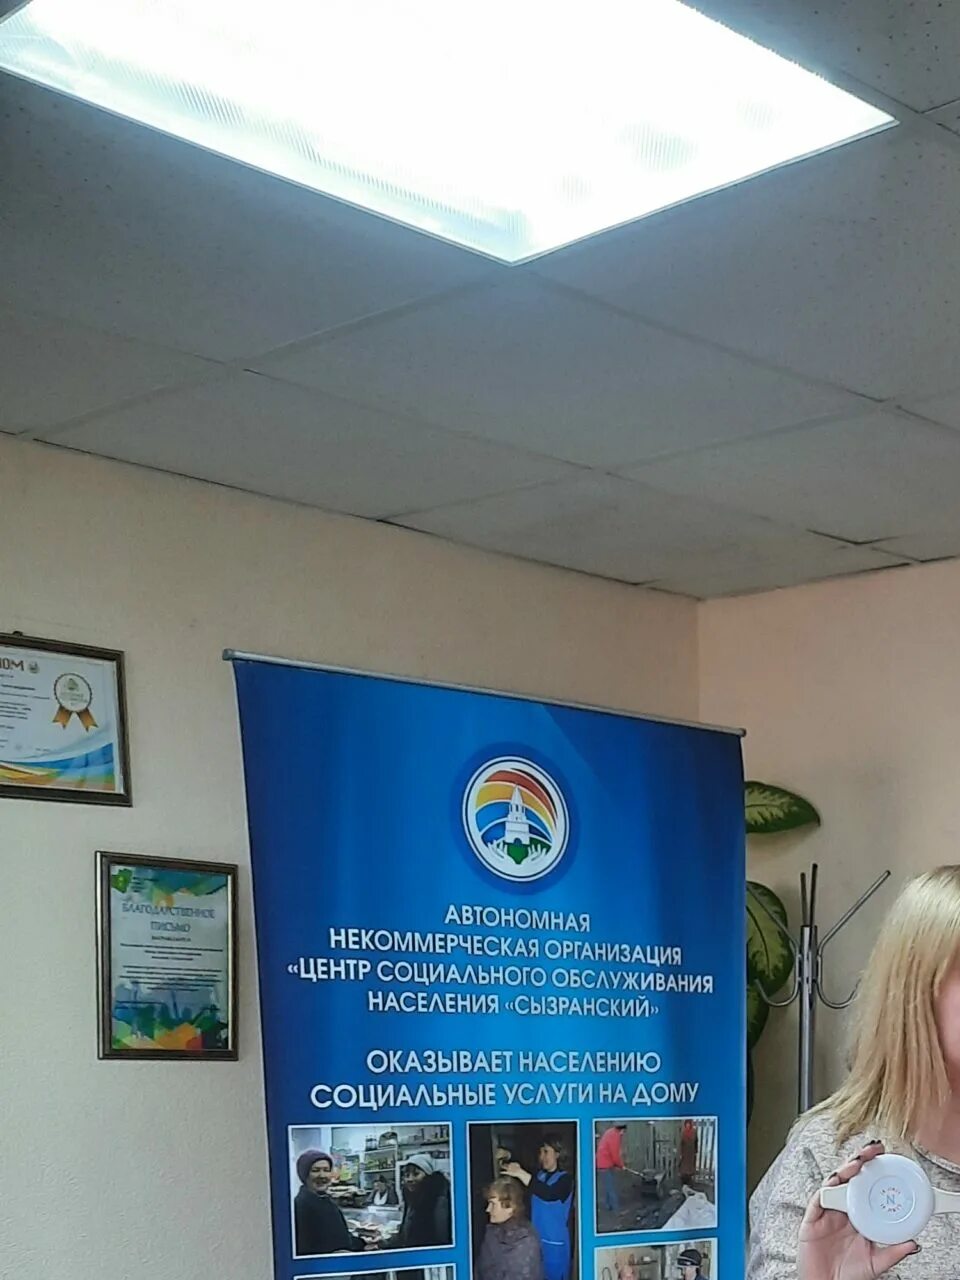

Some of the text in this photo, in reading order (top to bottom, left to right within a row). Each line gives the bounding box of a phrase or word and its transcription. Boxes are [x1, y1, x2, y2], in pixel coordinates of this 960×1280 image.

[444, 904, 591, 932] АВТОНОМНАЯ
[329, 928, 682, 967] НЕКОММЕРЧЕСКАЯ ОРГАНИЗАЦИЯ
[287, 957, 714, 994] «ЦЕНТР СОЦИАЛЬНОГО ОБСЛУЖИВАНИЯ
[367, 991, 660, 1018] НАСЕЛЕНИЯ «СЫЗРАНСКИЙ»
[366, 1050, 662, 1074] ОКАЗЫВАЕТ НАСЕЛЕНИЮ
[310, 1081, 700, 1111] СОЦИАЛЬНЫЕ УСЛУГИ НА ДОМУ
